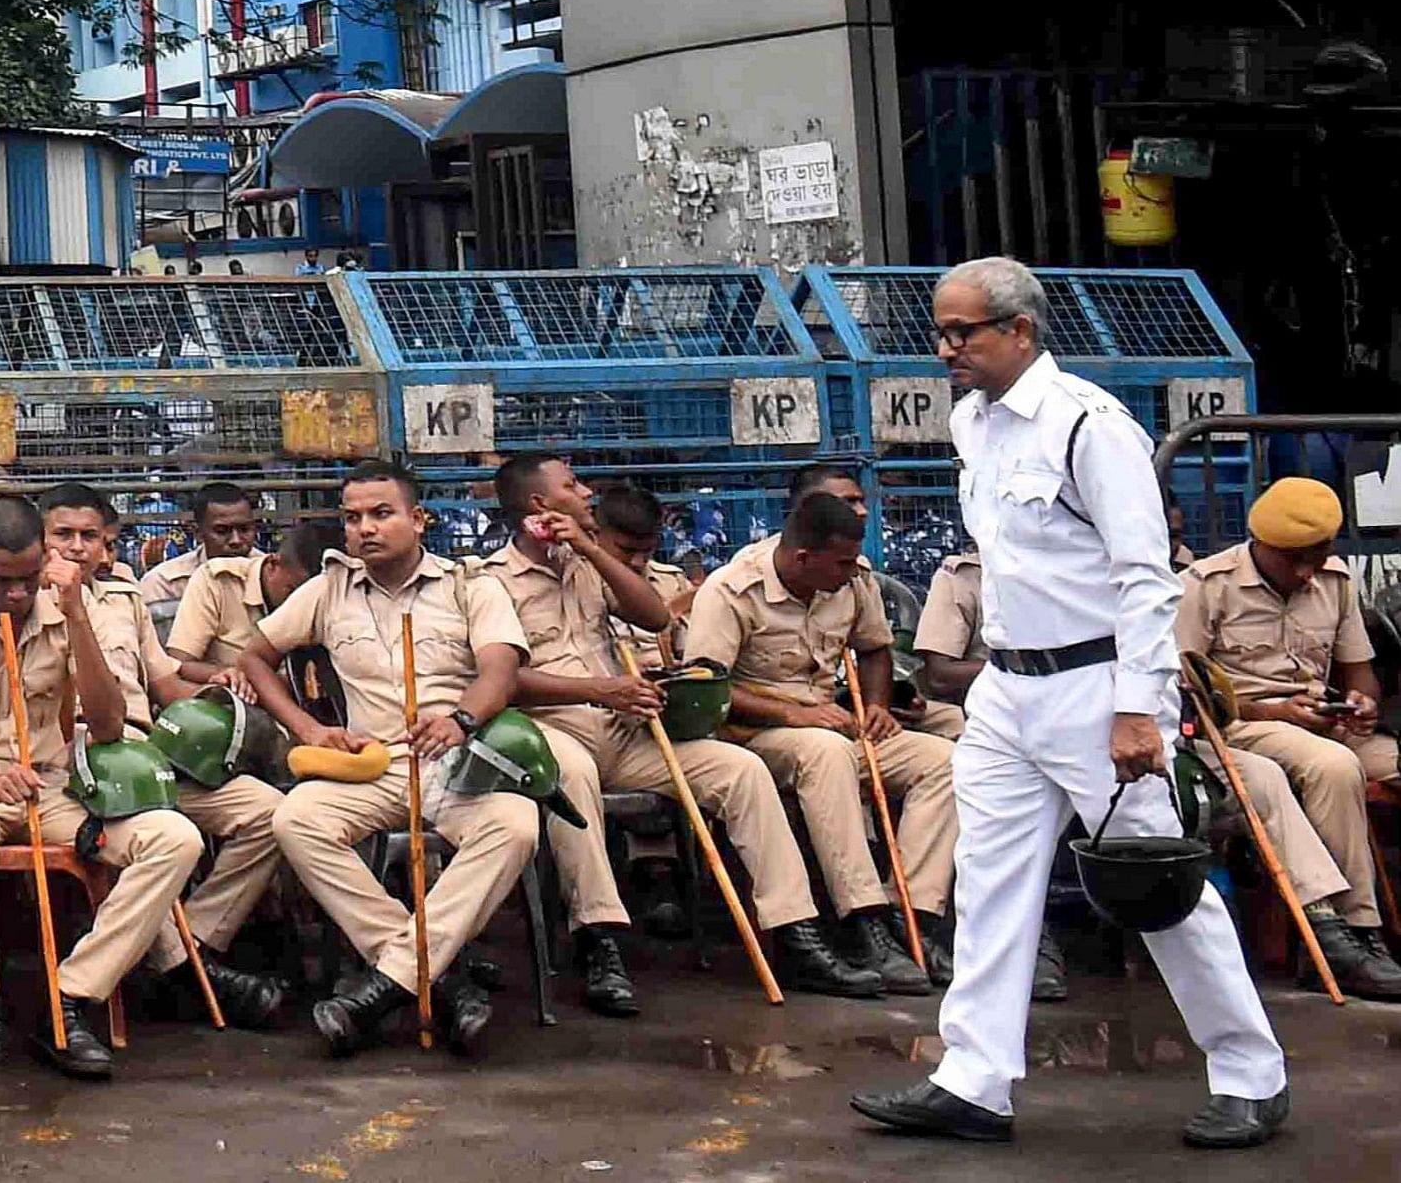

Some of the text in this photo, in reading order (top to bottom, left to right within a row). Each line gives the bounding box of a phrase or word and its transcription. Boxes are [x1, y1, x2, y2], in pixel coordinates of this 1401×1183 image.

[792, 161, 830, 182] ভাড়া
[426, 401, 471, 436] KP
[752, 393, 796, 428] KP
[891, 392, 931, 426] KP
[1187, 392, 1225, 420] KP
